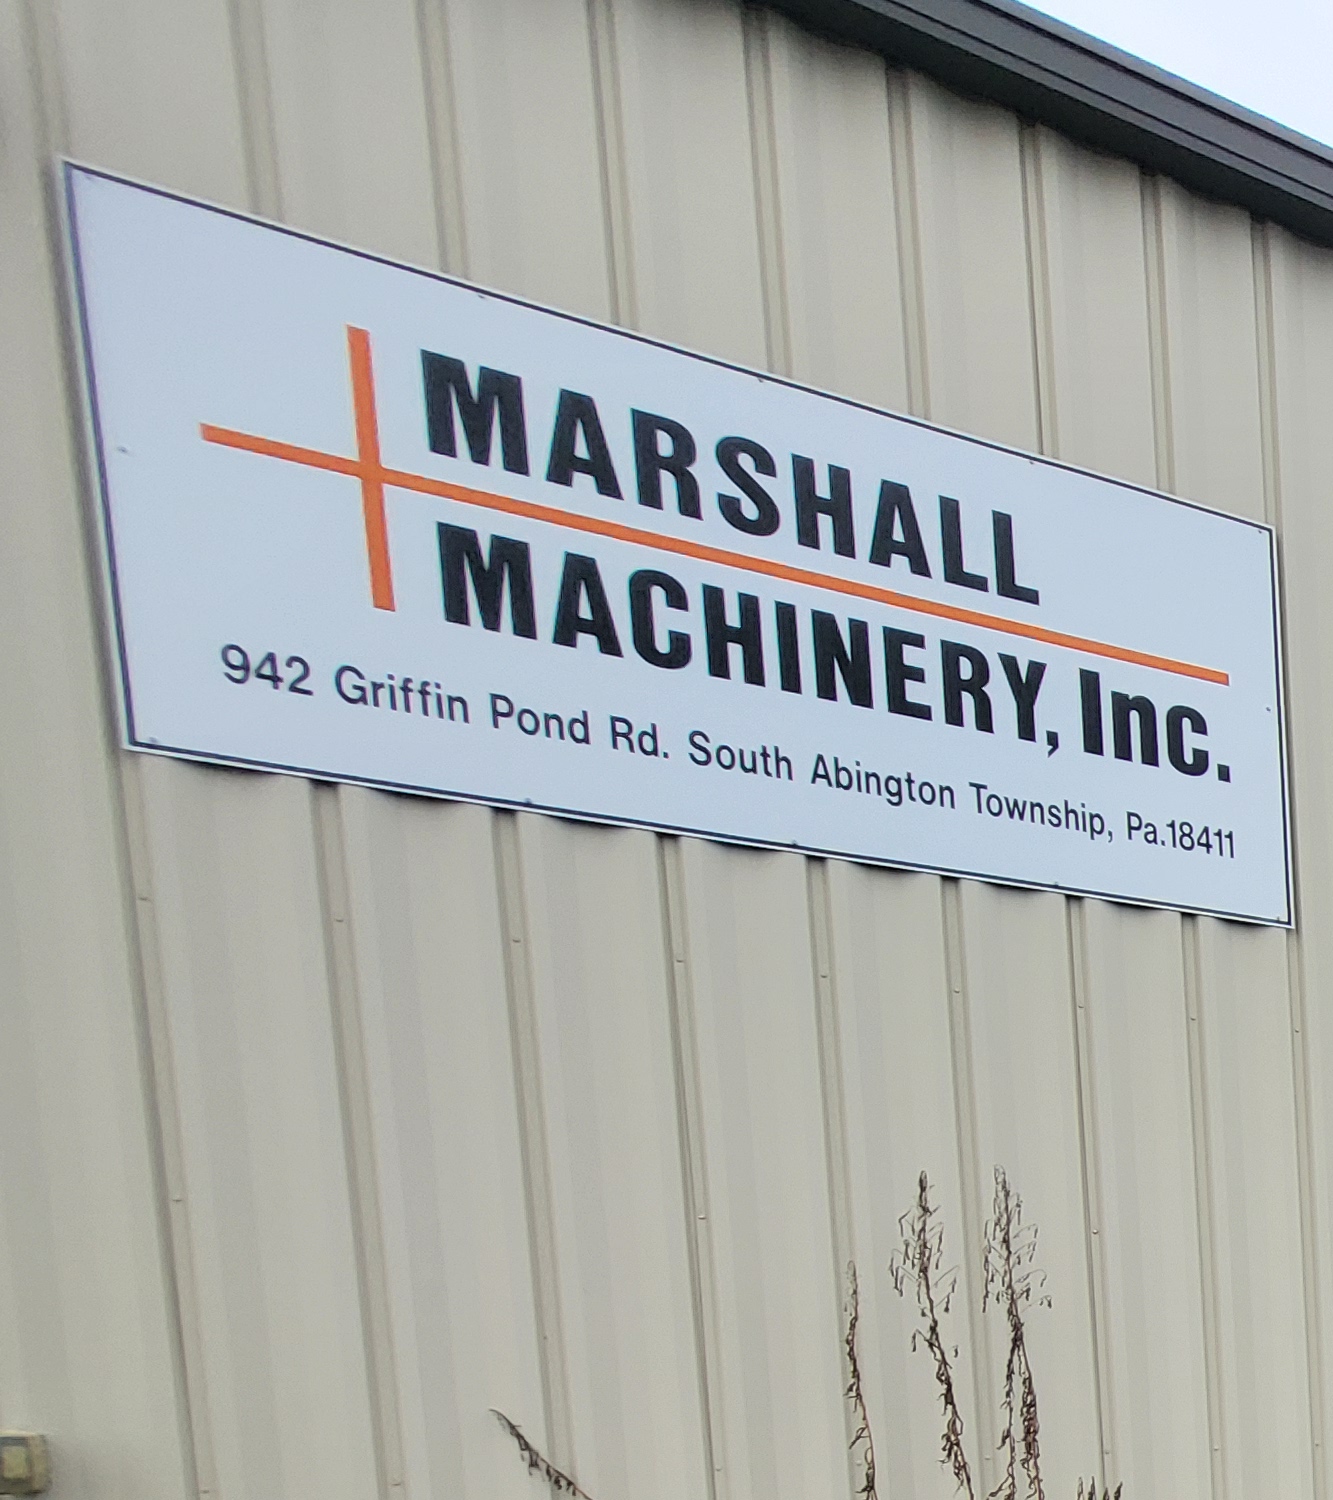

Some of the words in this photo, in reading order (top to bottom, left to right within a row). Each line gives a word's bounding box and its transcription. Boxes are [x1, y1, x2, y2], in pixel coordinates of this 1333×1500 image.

[421, 350, 1040, 606] MARSHALL
[222, 645, 314, 696] 942
[335, 666, 470, 724] Griffin
[490, 693, 591, 745] Pond
[610, 716, 670, 758] Rd.
[689, 731, 793, 781] South
[811, 754, 956, 809] Abington
[969, 782, 1113, 843] Township,
[437, 522, 1059, 757] MACHINERY,
[1079, 668, 1231, 784] Inc.
